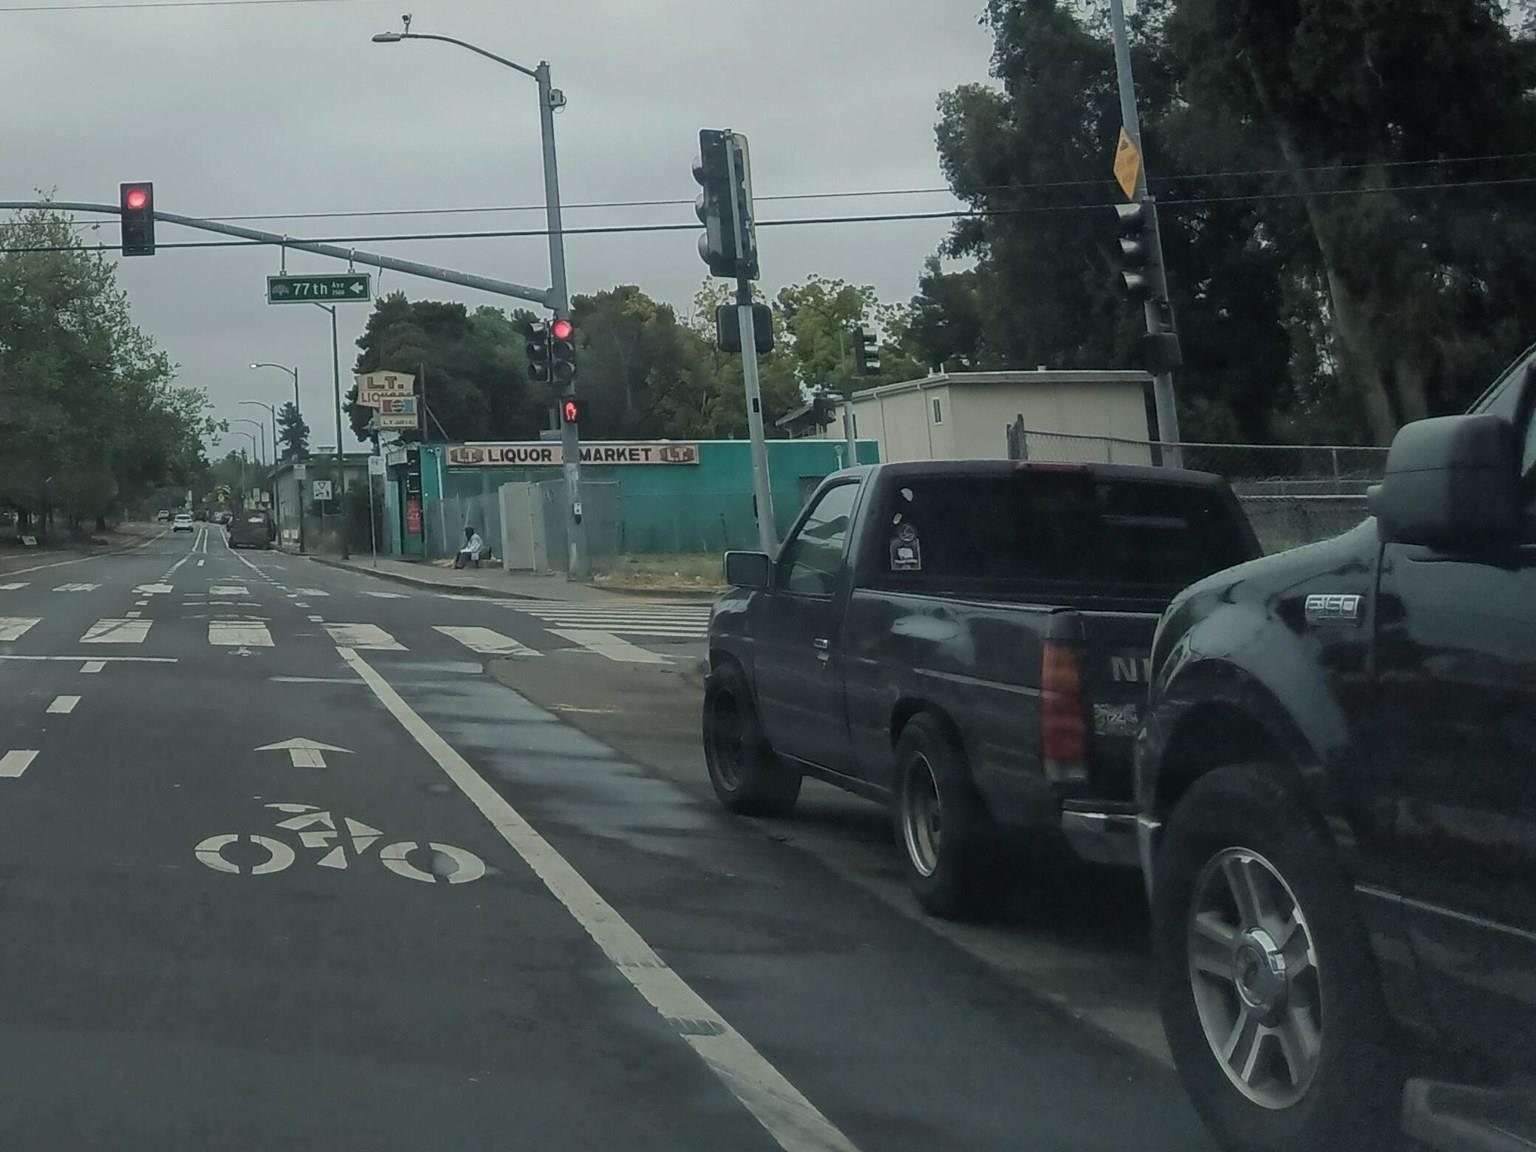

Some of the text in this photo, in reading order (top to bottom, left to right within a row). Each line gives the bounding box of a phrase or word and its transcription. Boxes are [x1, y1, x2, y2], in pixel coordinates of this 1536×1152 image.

[293, 282, 328, 296] 77th
[488, 449, 552, 463] LIQUOR
[579, 448, 652, 462] MARKET
